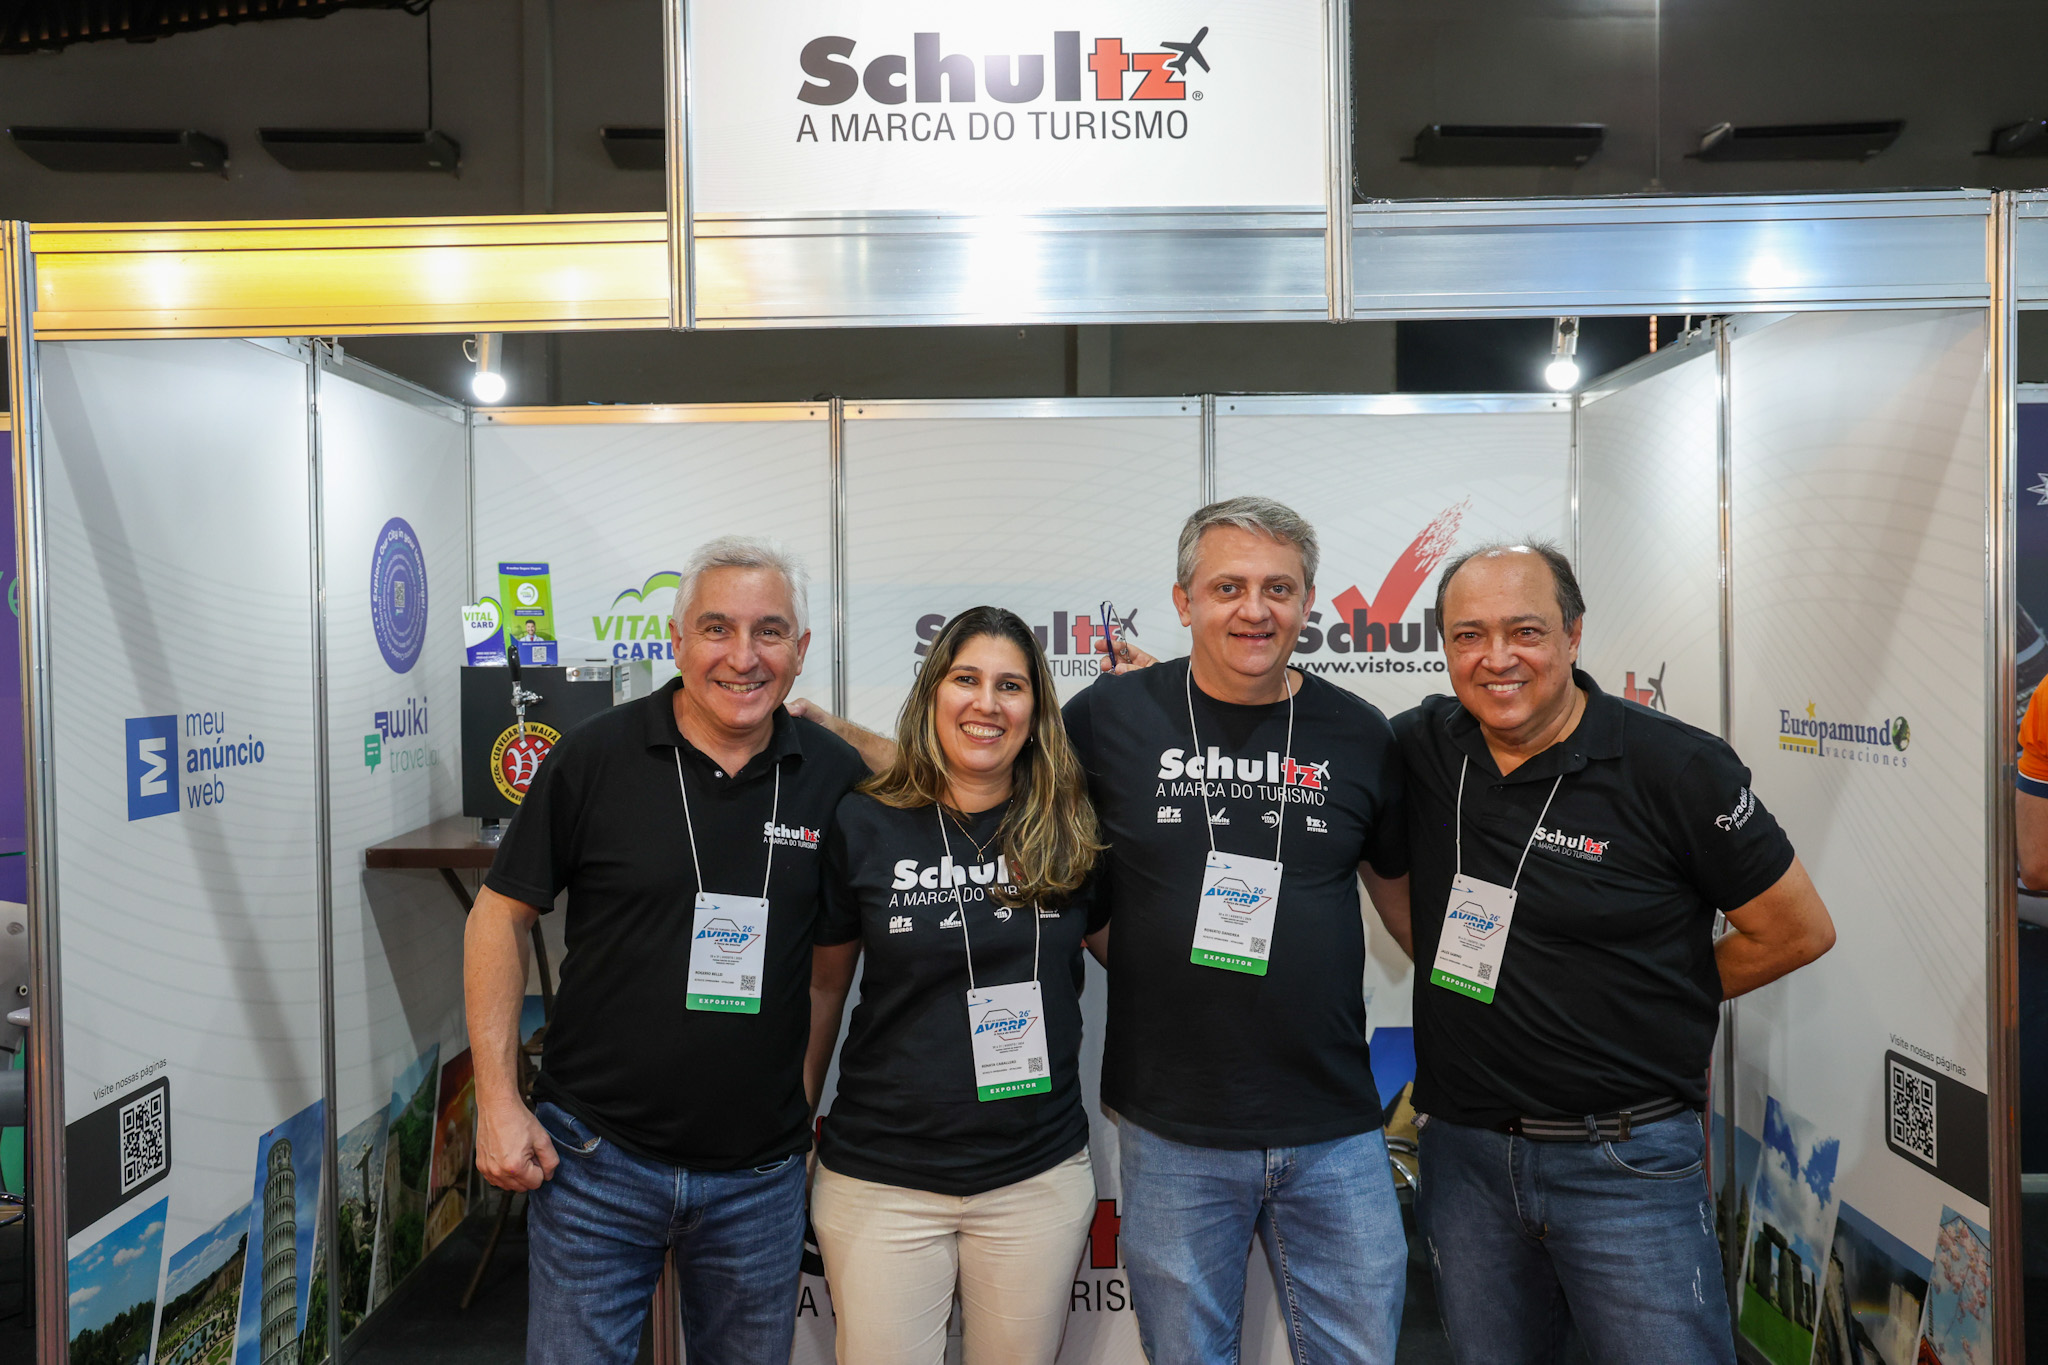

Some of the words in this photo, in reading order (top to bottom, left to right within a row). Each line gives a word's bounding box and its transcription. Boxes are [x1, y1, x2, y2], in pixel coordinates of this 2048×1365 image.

[796, 30, 1187, 106] Schultz
[796, 113, 819, 142] A
[831, 112, 956, 142] MARCA
[968, 111, 1015, 141] DO
[1027, 109, 1189, 140] TURISMO
[463, 612, 493, 621] VITAL
[471, 621, 494, 629] CARD
[1293, 608, 1439, 654] Schul
[1049, 659, 1102, 677] TURIS
[1290, 656, 1449, 673] www.vistos.co
[186, 711, 225, 737] meu
[186, 734, 265, 773] anúncio
[493, 725, 527, 761] CERVEJARA
[1157, 746, 1322, 790] Schultz
[1825, 746, 1908, 768] vacaciones
[187, 774, 225, 809] web
[1155, 782, 1166, 798] A
[1170, 782, 1226, 798] MARCA
[1231, 783, 1253, 799] DO
[1256, 785, 1325, 807] TURISMO
[763, 821, 817, 843] Schultz
[789, 839, 797, 847] DO
[1534, 826, 1603, 855] Schultz
[1537, 842, 1560, 854] MARCA
[1561, 847, 1572, 856] DO
[1572, 850, 1602, 862] TURISMO
[891, 854, 1010, 891] Schul
[888, 893, 899, 908] A
[903, 890, 959, 907] MARCA
[963, 887, 985, 903] DO
[1204, 887, 1260, 905] AVIRRP
[1447, 910, 1494, 931] AVIRRP
[695, 929, 749, 943] AVIRRP
[1203, 953, 1253, 967] EXPOSITOR
[1441, 975, 1482, 993] EXPOSITOR
[698, 998, 746, 1006] EXPOSITOR
[974, 1018, 1027, 1035] AVIRRP
[1889, 1032, 1909, 1050] Visite
[1909, 1044, 1935, 1062] nossas
[1935, 1056, 1967, 1077] páginas
[93, 1083, 114, 1101] Visite
[115, 1072, 140, 1091] nossas
[140, 1058, 167, 1080] páginas
[990, 1082, 1037, 1094] EXPOSITOR
[797, 1286, 819, 1317] A
